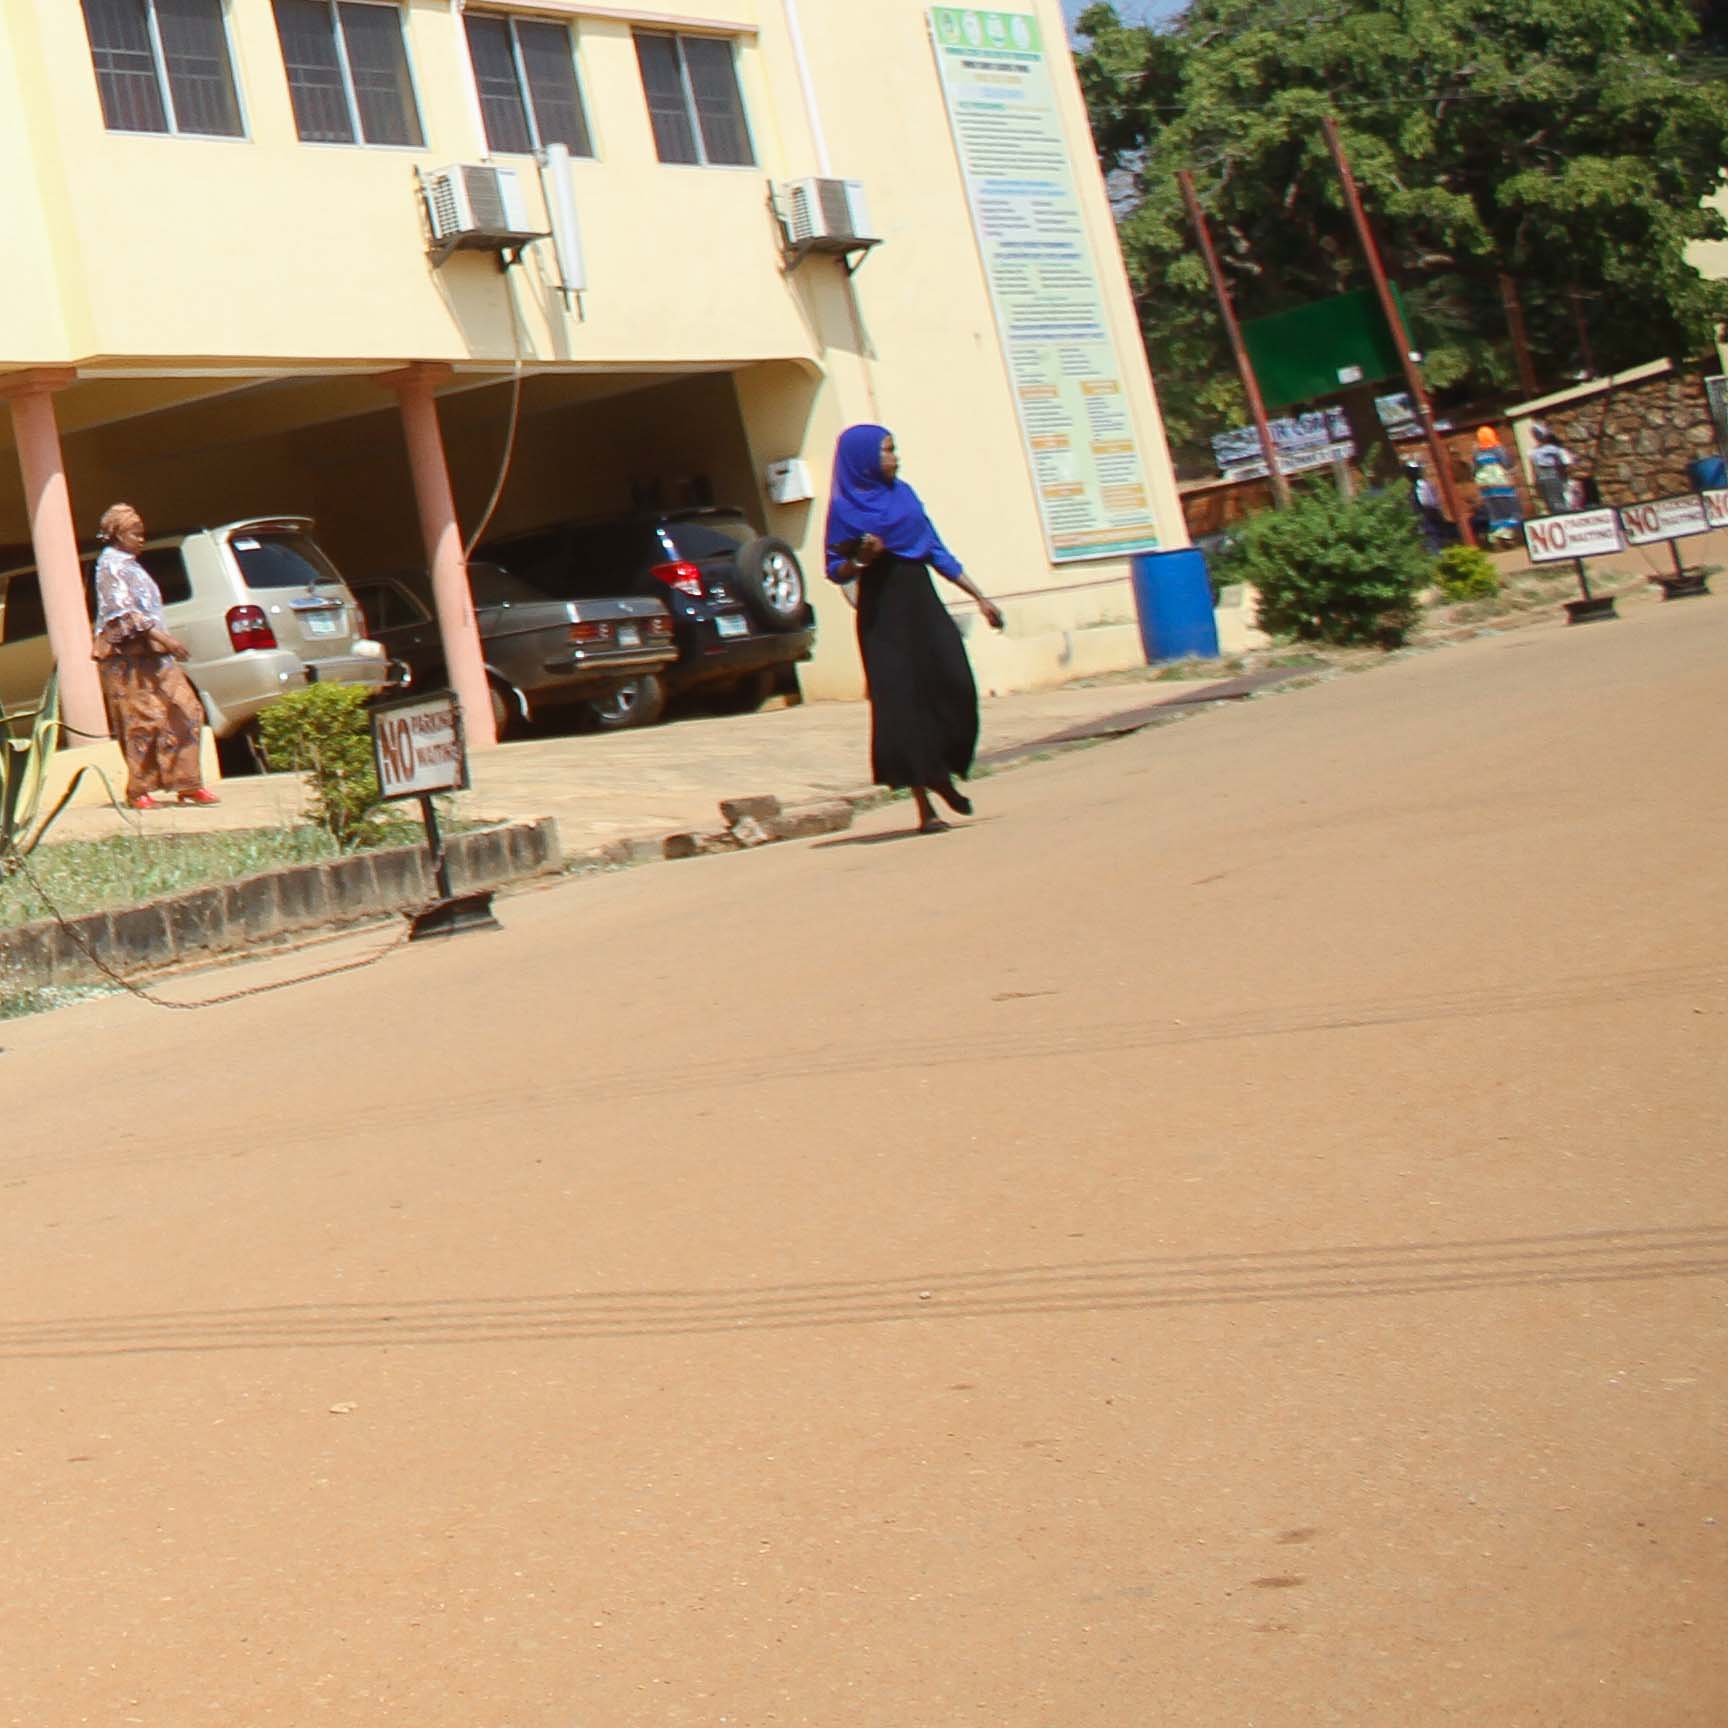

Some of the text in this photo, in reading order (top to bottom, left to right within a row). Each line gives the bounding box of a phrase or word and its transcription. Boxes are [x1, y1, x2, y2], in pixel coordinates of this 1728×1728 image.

[1624, 506, 1660, 533] NO
[1528, 522, 1567, 553] NO
[377, 718, 414, 784] NO
